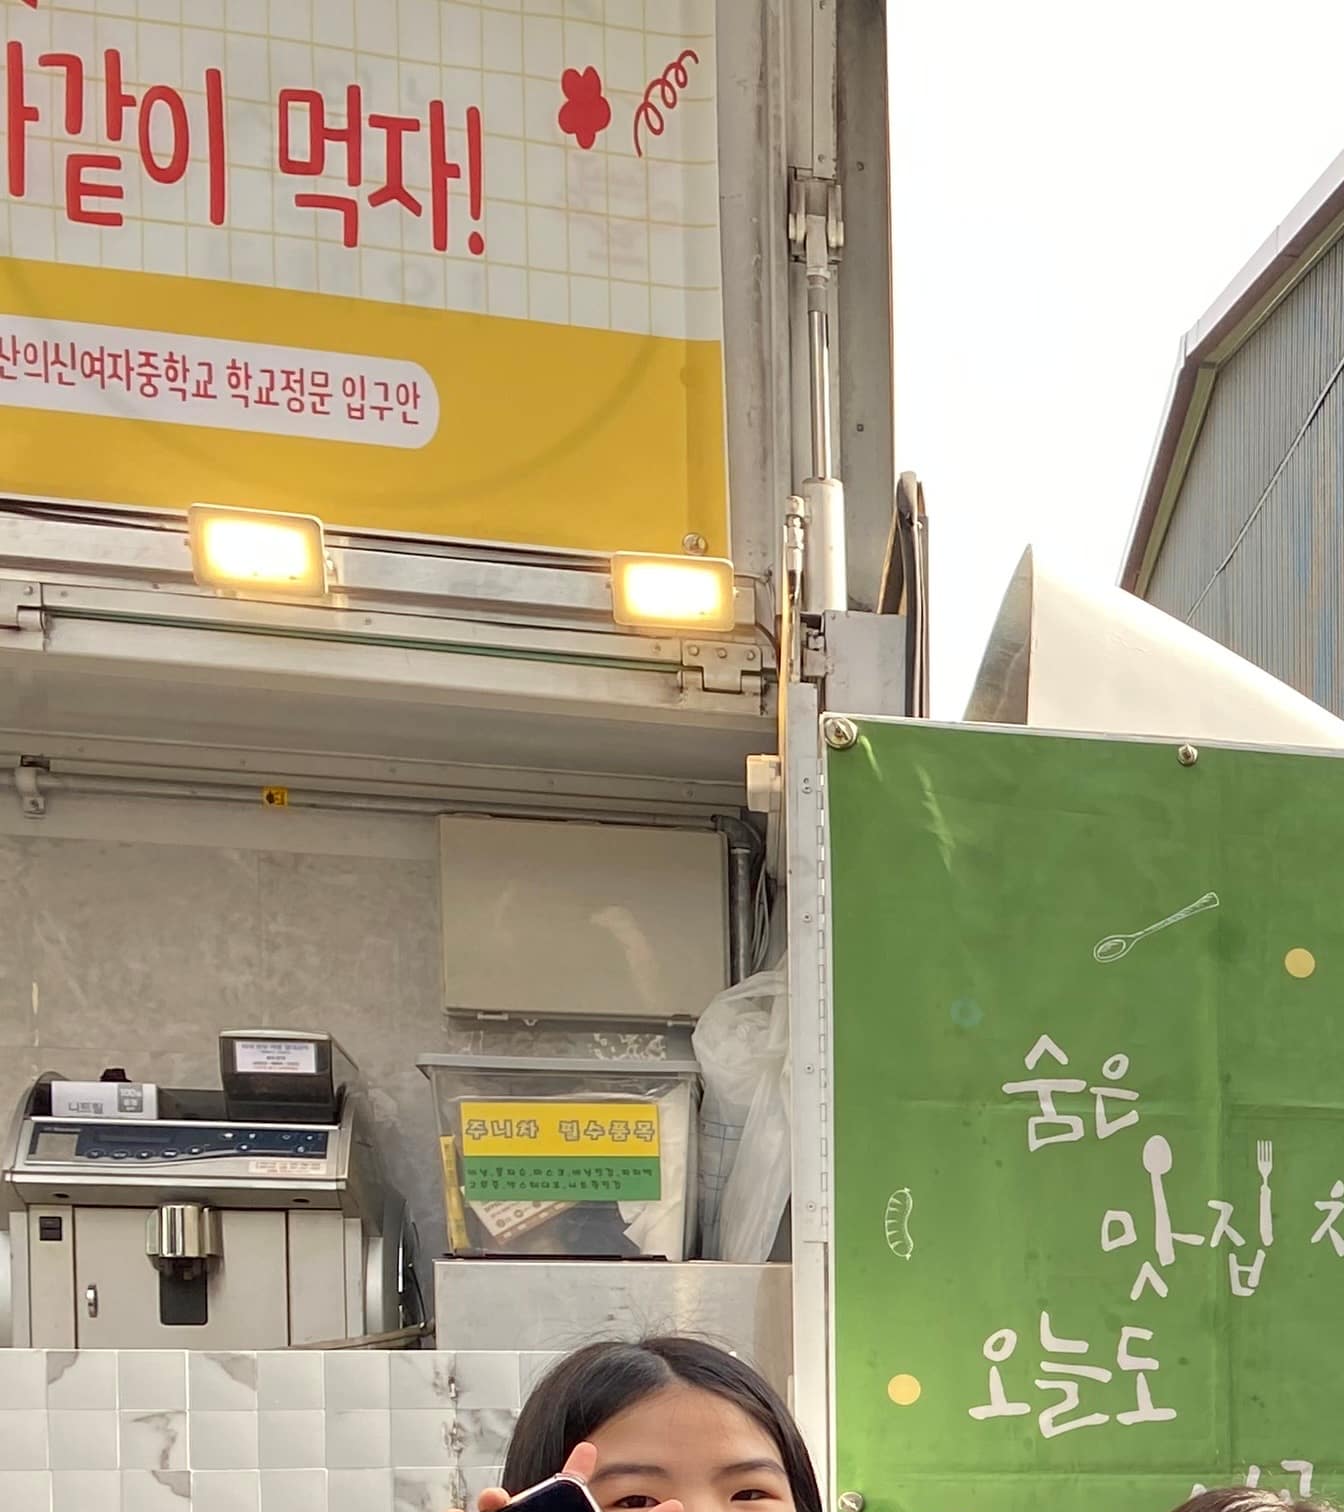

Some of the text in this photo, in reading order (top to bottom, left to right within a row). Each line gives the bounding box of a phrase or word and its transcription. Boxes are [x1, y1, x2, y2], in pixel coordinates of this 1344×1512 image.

[278, 84, 486, 256] 먹자!
[225, 356, 332, 416] 학교정문
[341, 376, 421, 425] 입구안
[558, 1119, 656, 1142] 필수품목
[1002, 1034, 1139, 1152] 숨은
[1099, 1134, 1274, 1301] 맛집
[968, 1310, 1178, 1438] 오늘도
